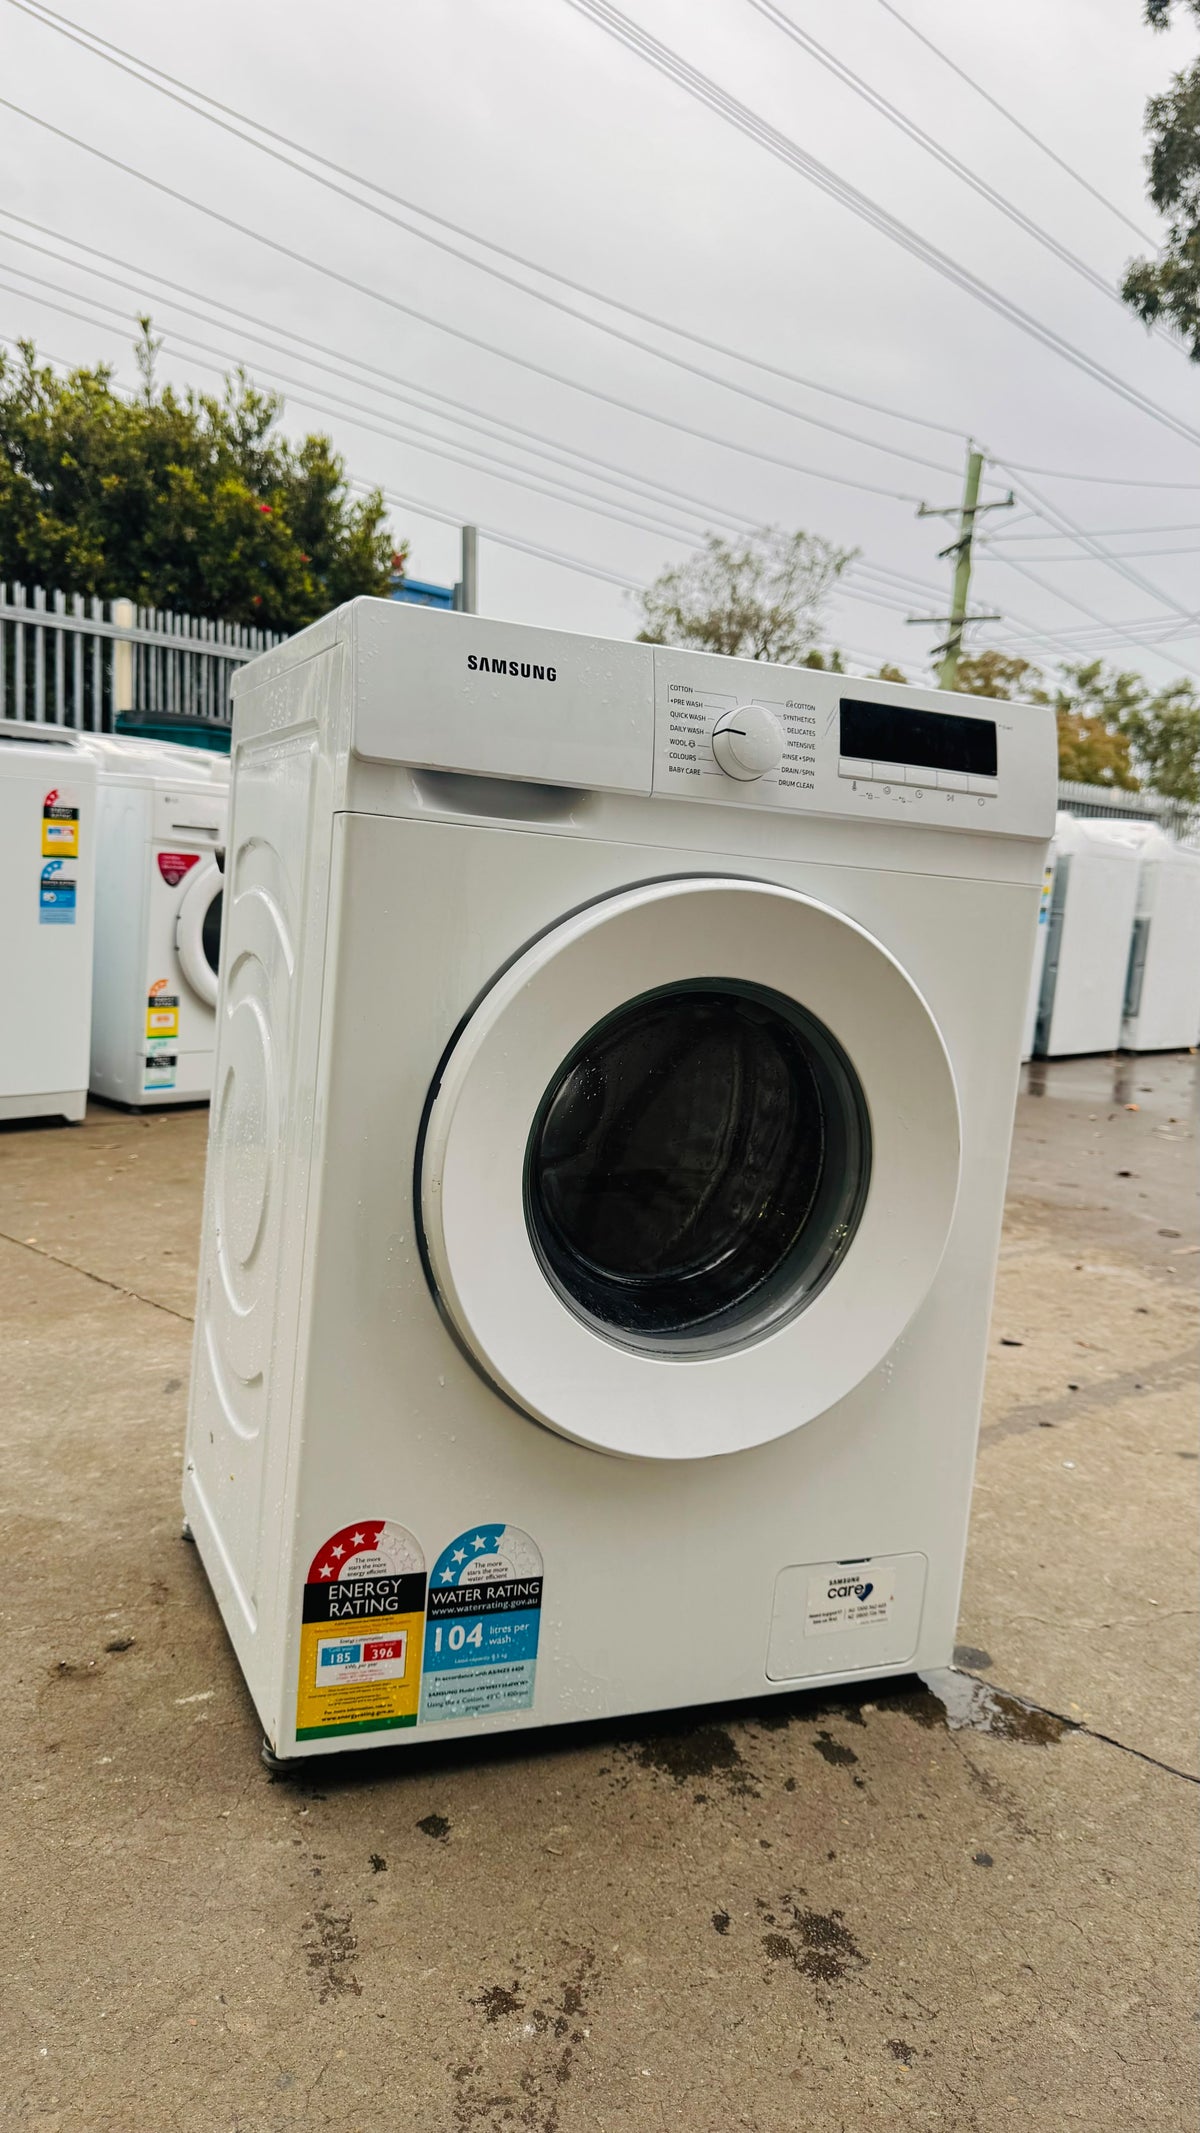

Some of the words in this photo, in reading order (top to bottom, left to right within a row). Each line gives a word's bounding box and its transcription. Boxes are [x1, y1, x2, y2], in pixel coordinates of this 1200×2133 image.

[467, 654, 557, 682] SAMSUNG
[670, 684, 693, 693] COTTON
[686, 700, 703, 708] WASH
[794, 702, 816, 711] COTTON
[670, 711, 688, 719] QUICK
[688, 713, 706, 721] WASH
[782, 714, 816, 724] SYNTHETICS
[670, 724, 686, 733] DAILY
[687, 727, 704, 735] WASH
[787, 728, 816, 737] DELICATES
[669, 738, 687, 747] WOOL
[787, 741, 816, 750] INTENSIVE
[669, 752, 696, 761] COLOURS
[669, 766, 684, 774] BABY
[686, 768, 701, 776] CARE
[778, 779, 795, 788] DRUM
[796, 781, 814, 790] CLEAN
[329, 1579, 402, 1600] ENERGY
[432, 1588, 482, 1605] WATER
[486, 1582, 540, 1599] RATING
[827, 1584, 864, 1599] care
[329, 1597, 399, 1617] RATING
[431, 1597, 538, 1616] www.waterrating.gov.au
[489, 1624, 512, 1635] litres
[514, 1623, 530, 1634] per
[434, 1622, 483, 1653] 104
[489, 1635, 511, 1645] wash
[330, 1652, 351, 1664] 185
[372, 1647, 394, 1660] 396
